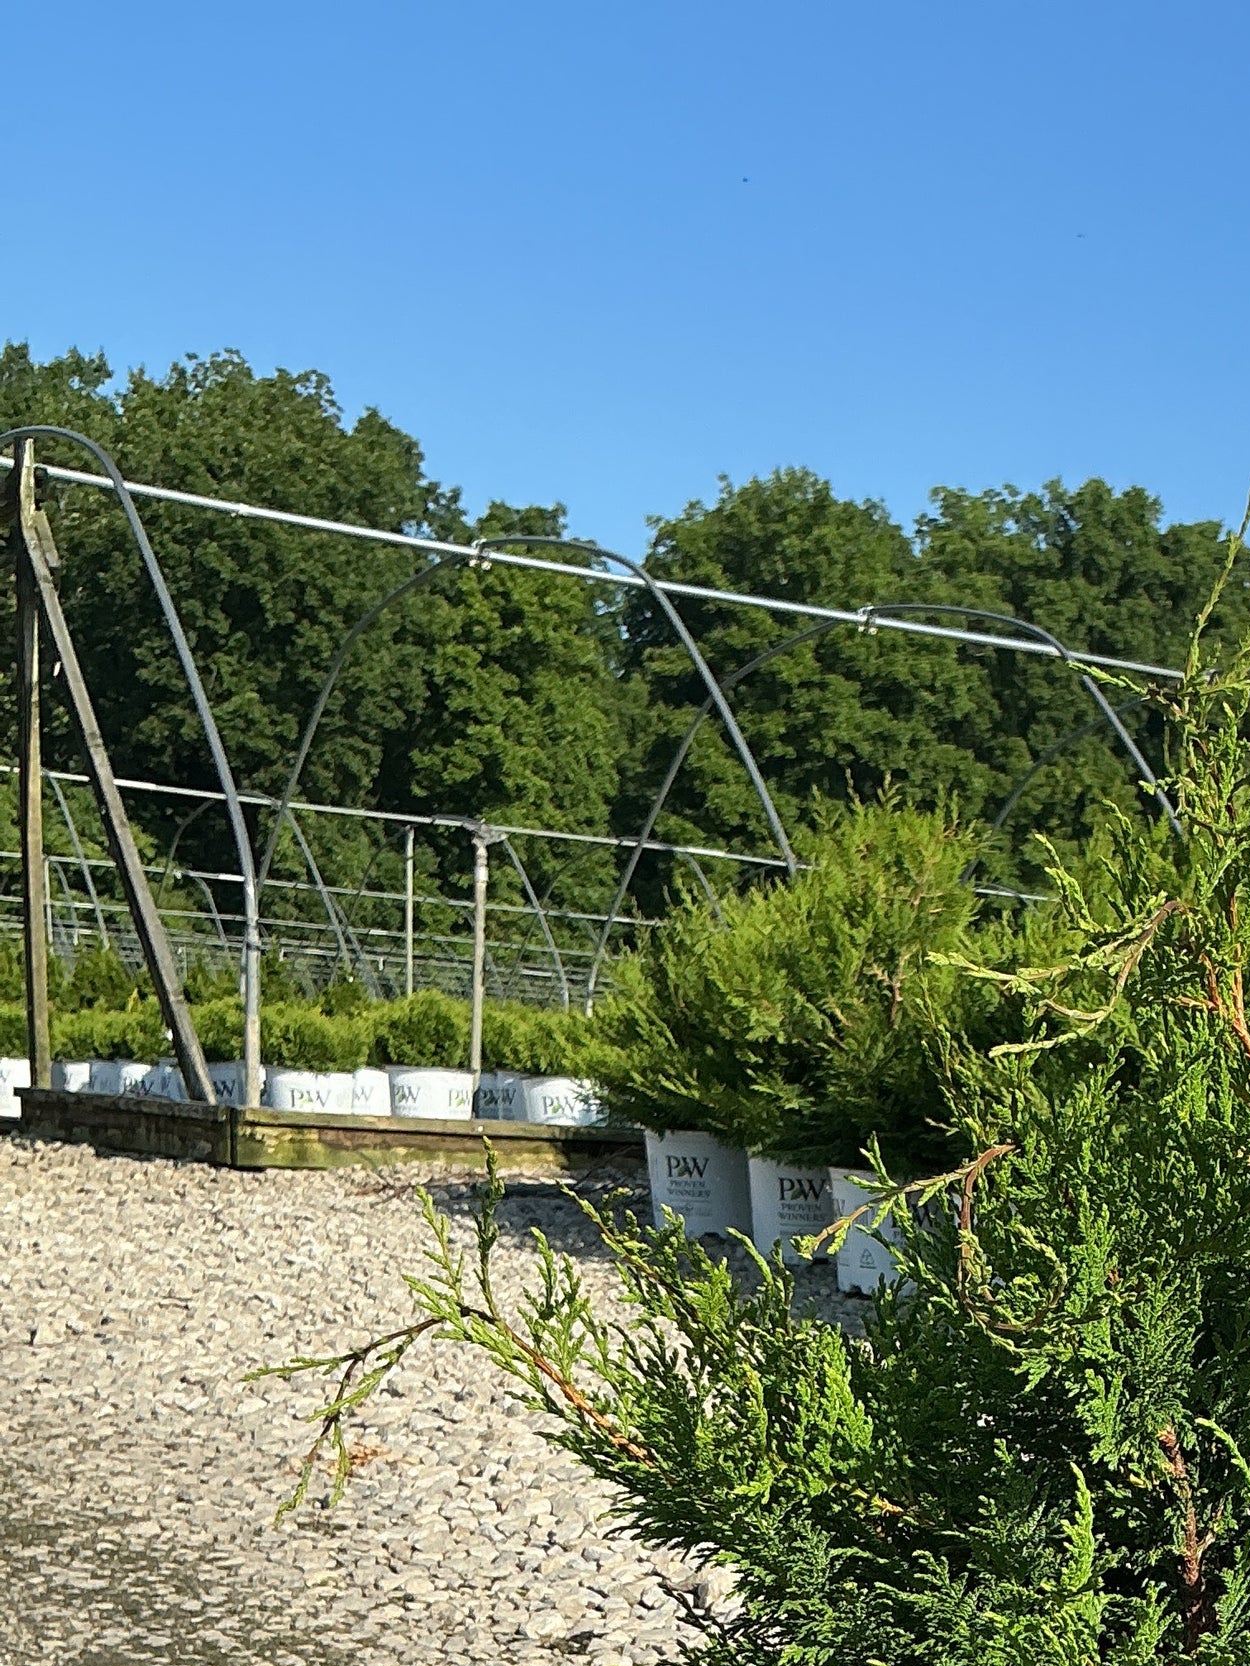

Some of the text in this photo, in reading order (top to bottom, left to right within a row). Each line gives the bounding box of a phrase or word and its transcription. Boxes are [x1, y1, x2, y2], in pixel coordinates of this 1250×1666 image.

[290, 1088, 332, 1108] PW
[542, 1096, 579, 1115] PW
[665, 1155, 709, 1179] PW
[778, 1177, 827, 1201] PW
[781, 1203, 822, 1212] PROVEN
[778, 1213, 826, 1222] WINNERS
